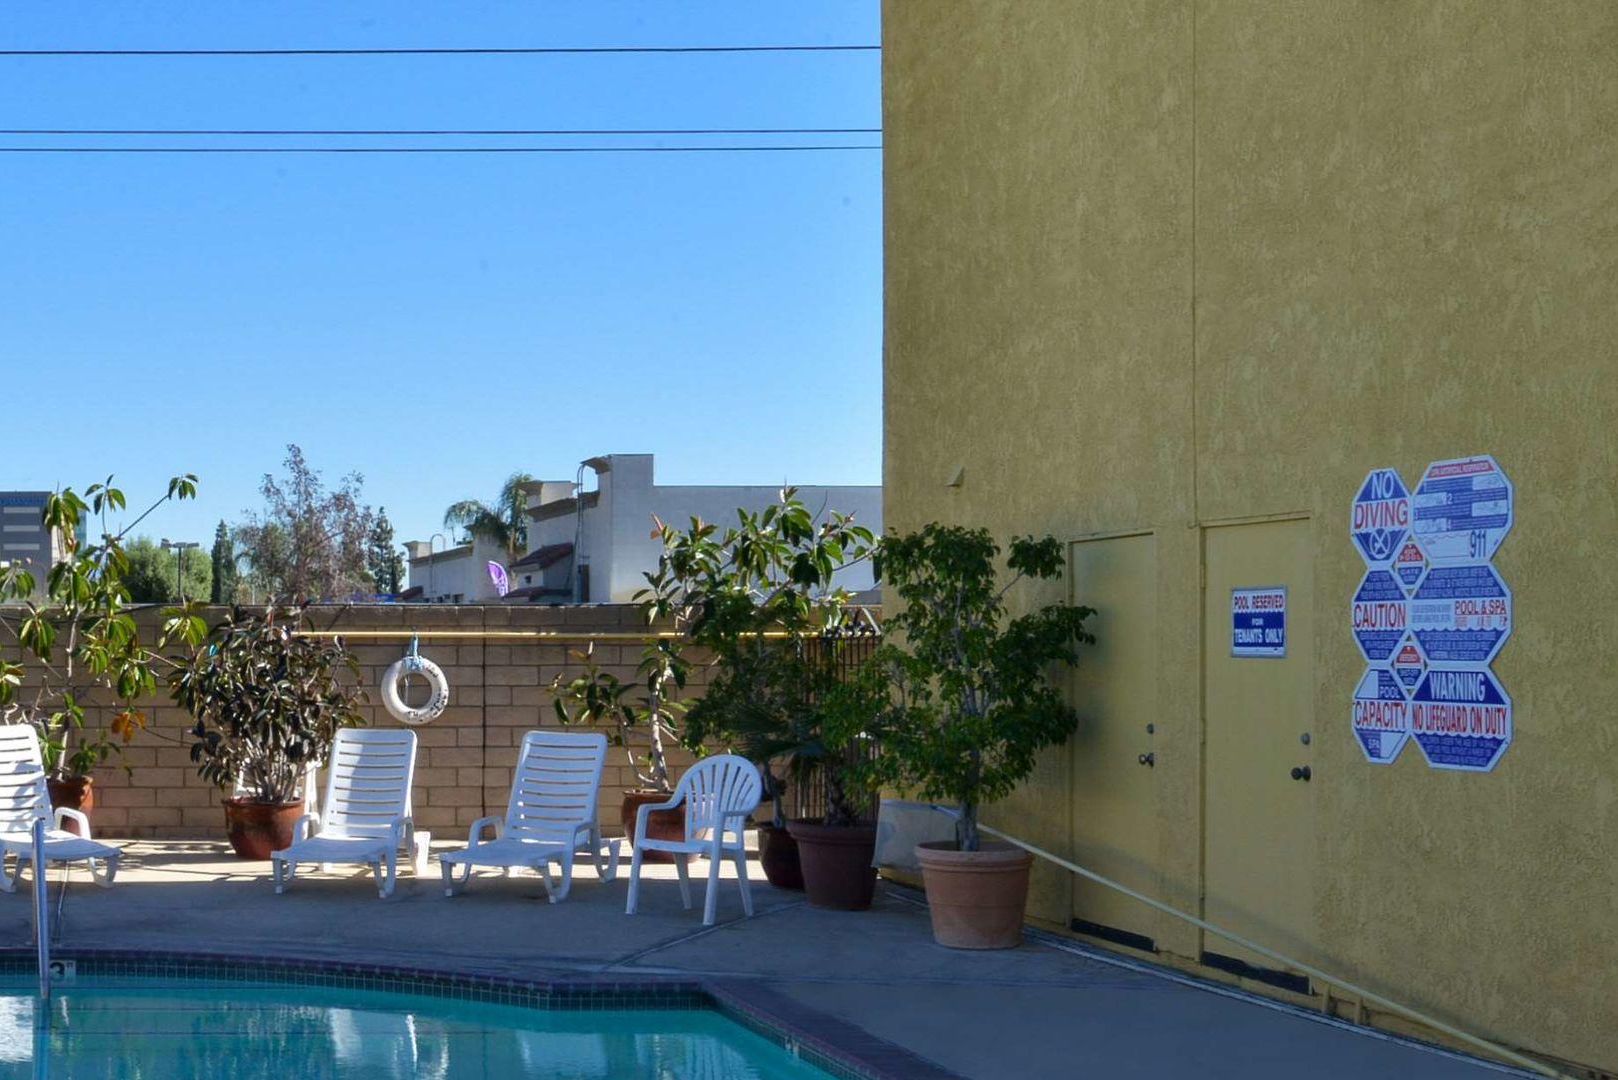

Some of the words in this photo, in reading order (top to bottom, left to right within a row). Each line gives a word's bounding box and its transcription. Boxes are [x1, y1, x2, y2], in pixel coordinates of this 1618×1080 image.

[1371, 472, 1394, 499] NO
[1447, 493, 1453, 504] 2
[1354, 499, 1408, 529] DIVING
[1469, 530, 1487, 558] 911
[1234, 595, 1249, 609] POOL
[1252, 594, 1283, 609] RESERVED
[1354, 602, 1407, 627] CAUTION
[1455, 601, 1478, 616] POOL
[1489, 600, 1506, 615] SPA
[1234, 629, 1262, 643] TENANTS
[1265, 628, 1284, 643] ONLY
[1379, 687, 1401, 698] POOL
[1430, 672, 1486, 700] WARNING
[1354, 700, 1407, 727] CAPACITY
[1412, 703, 1423, 730] NO
[1426, 704, 1467, 732] LIFEGUARD
[1470, 705, 1482, 734] ON
[1485, 706, 1506, 736] DUTY
